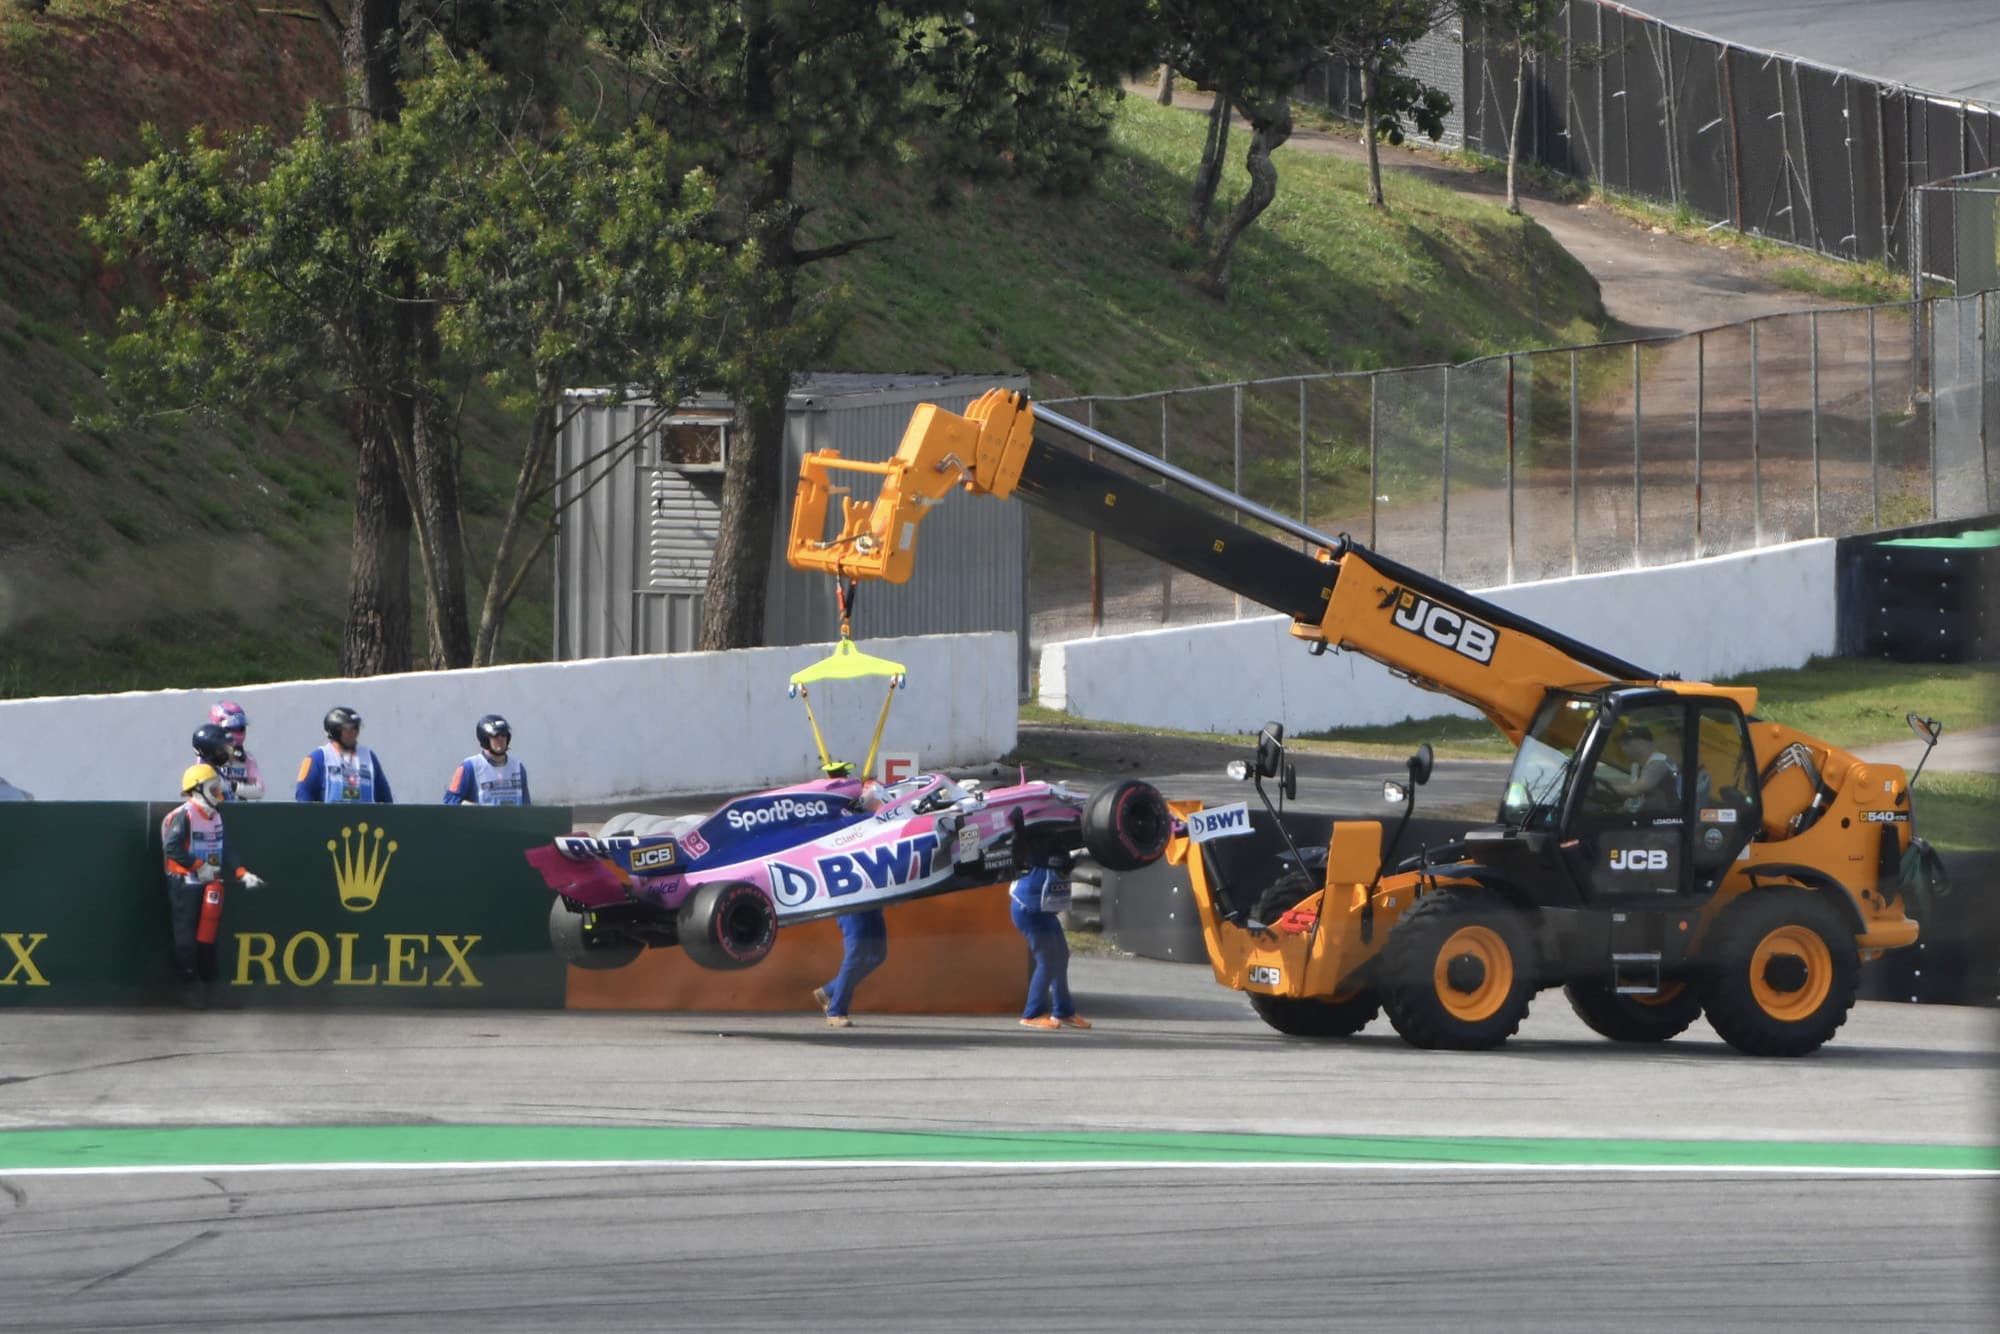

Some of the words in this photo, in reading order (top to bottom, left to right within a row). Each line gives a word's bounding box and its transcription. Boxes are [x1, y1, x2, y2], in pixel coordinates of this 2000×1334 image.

[1395, 599, 1495, 662] JCB
[727, 799, 828, 831] SportPesa
[875, 809, 904, 825] NEC
[1206, 809, 1245, 832] BWT
[634, 848, 672, 867] JCB
[680, 831, 710, 860] 18
[1610, 849, 1668, 870] JCB
[817, 833, 939, 898] BWT
[0, 933, 51, 986] X
[231, 931, 484, 987] ROLEX
[1249, 965, 1280, 985] JCB
